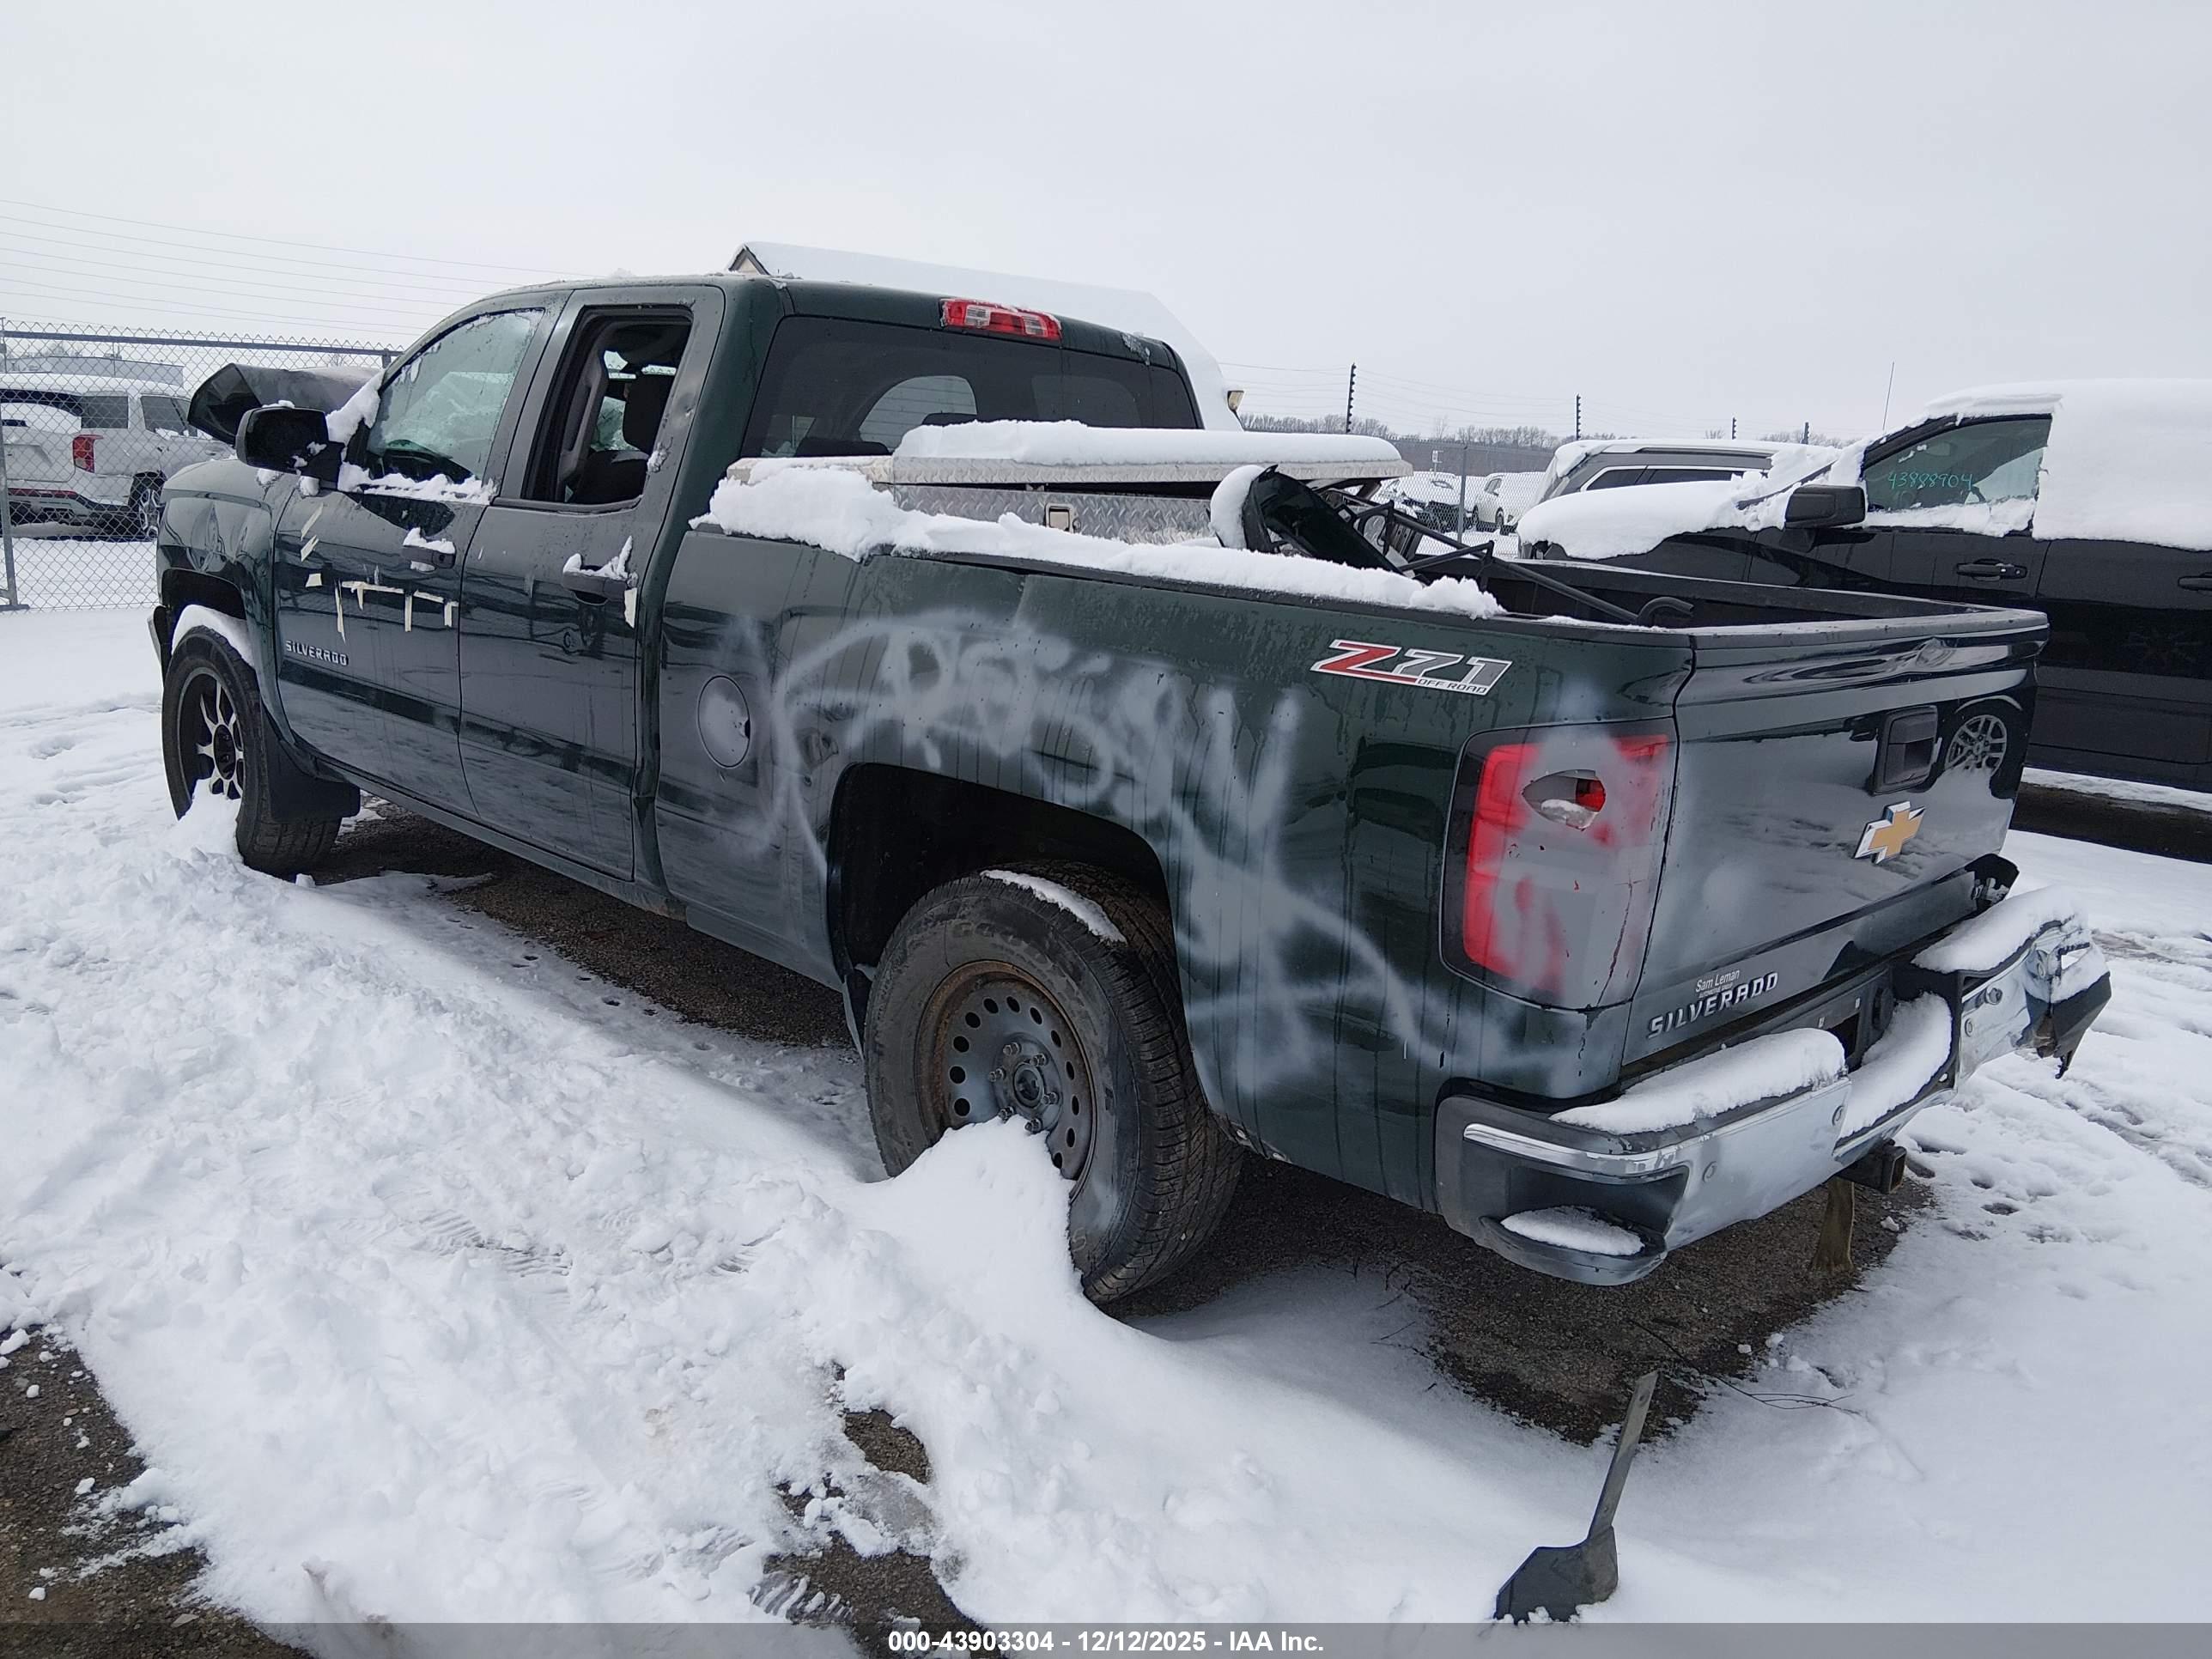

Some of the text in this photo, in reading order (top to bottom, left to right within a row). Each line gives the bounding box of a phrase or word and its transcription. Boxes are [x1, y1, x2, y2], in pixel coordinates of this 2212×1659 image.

[1887, 471, 1972, 491] 43888904
[285, 640, 348, 666] SILVERADO
[1310, 639, 1512, 687] Z71
[1695, 969, 1741, 993] Sam Leman
[1648, 972, 1778, 1039] SILVERADO
